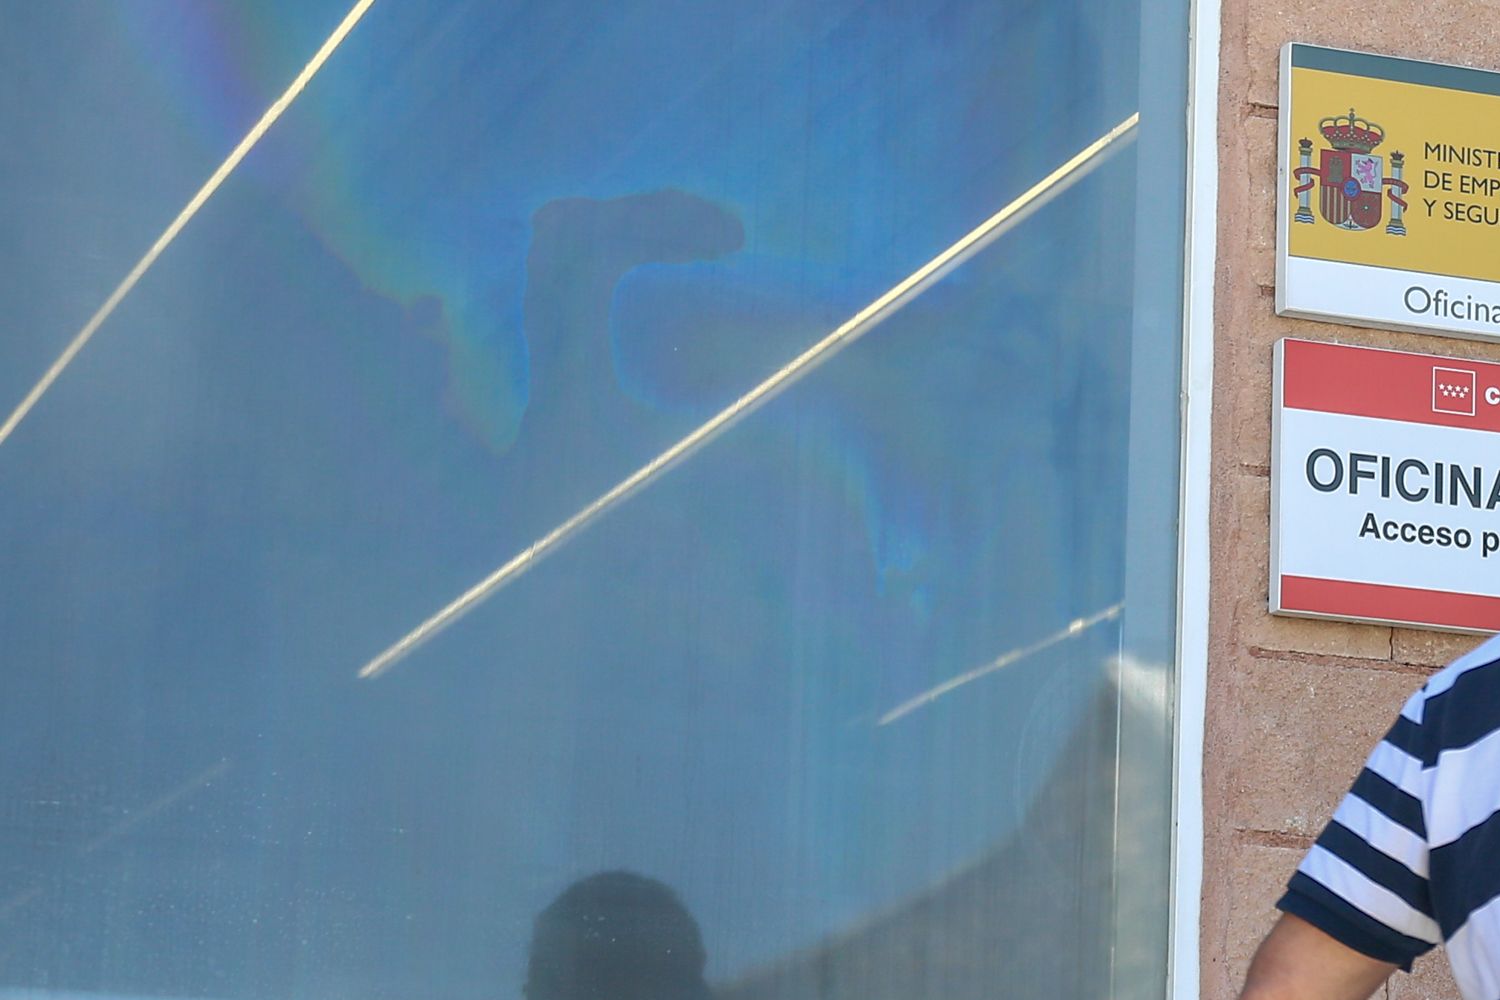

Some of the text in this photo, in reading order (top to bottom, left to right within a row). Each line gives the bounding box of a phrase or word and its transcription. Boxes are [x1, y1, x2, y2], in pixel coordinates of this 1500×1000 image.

[1424, 170, 1453, 192] DE
[1423, 198, 1437, 218] Y
[1359, 513, 1471, 549] Acceso
